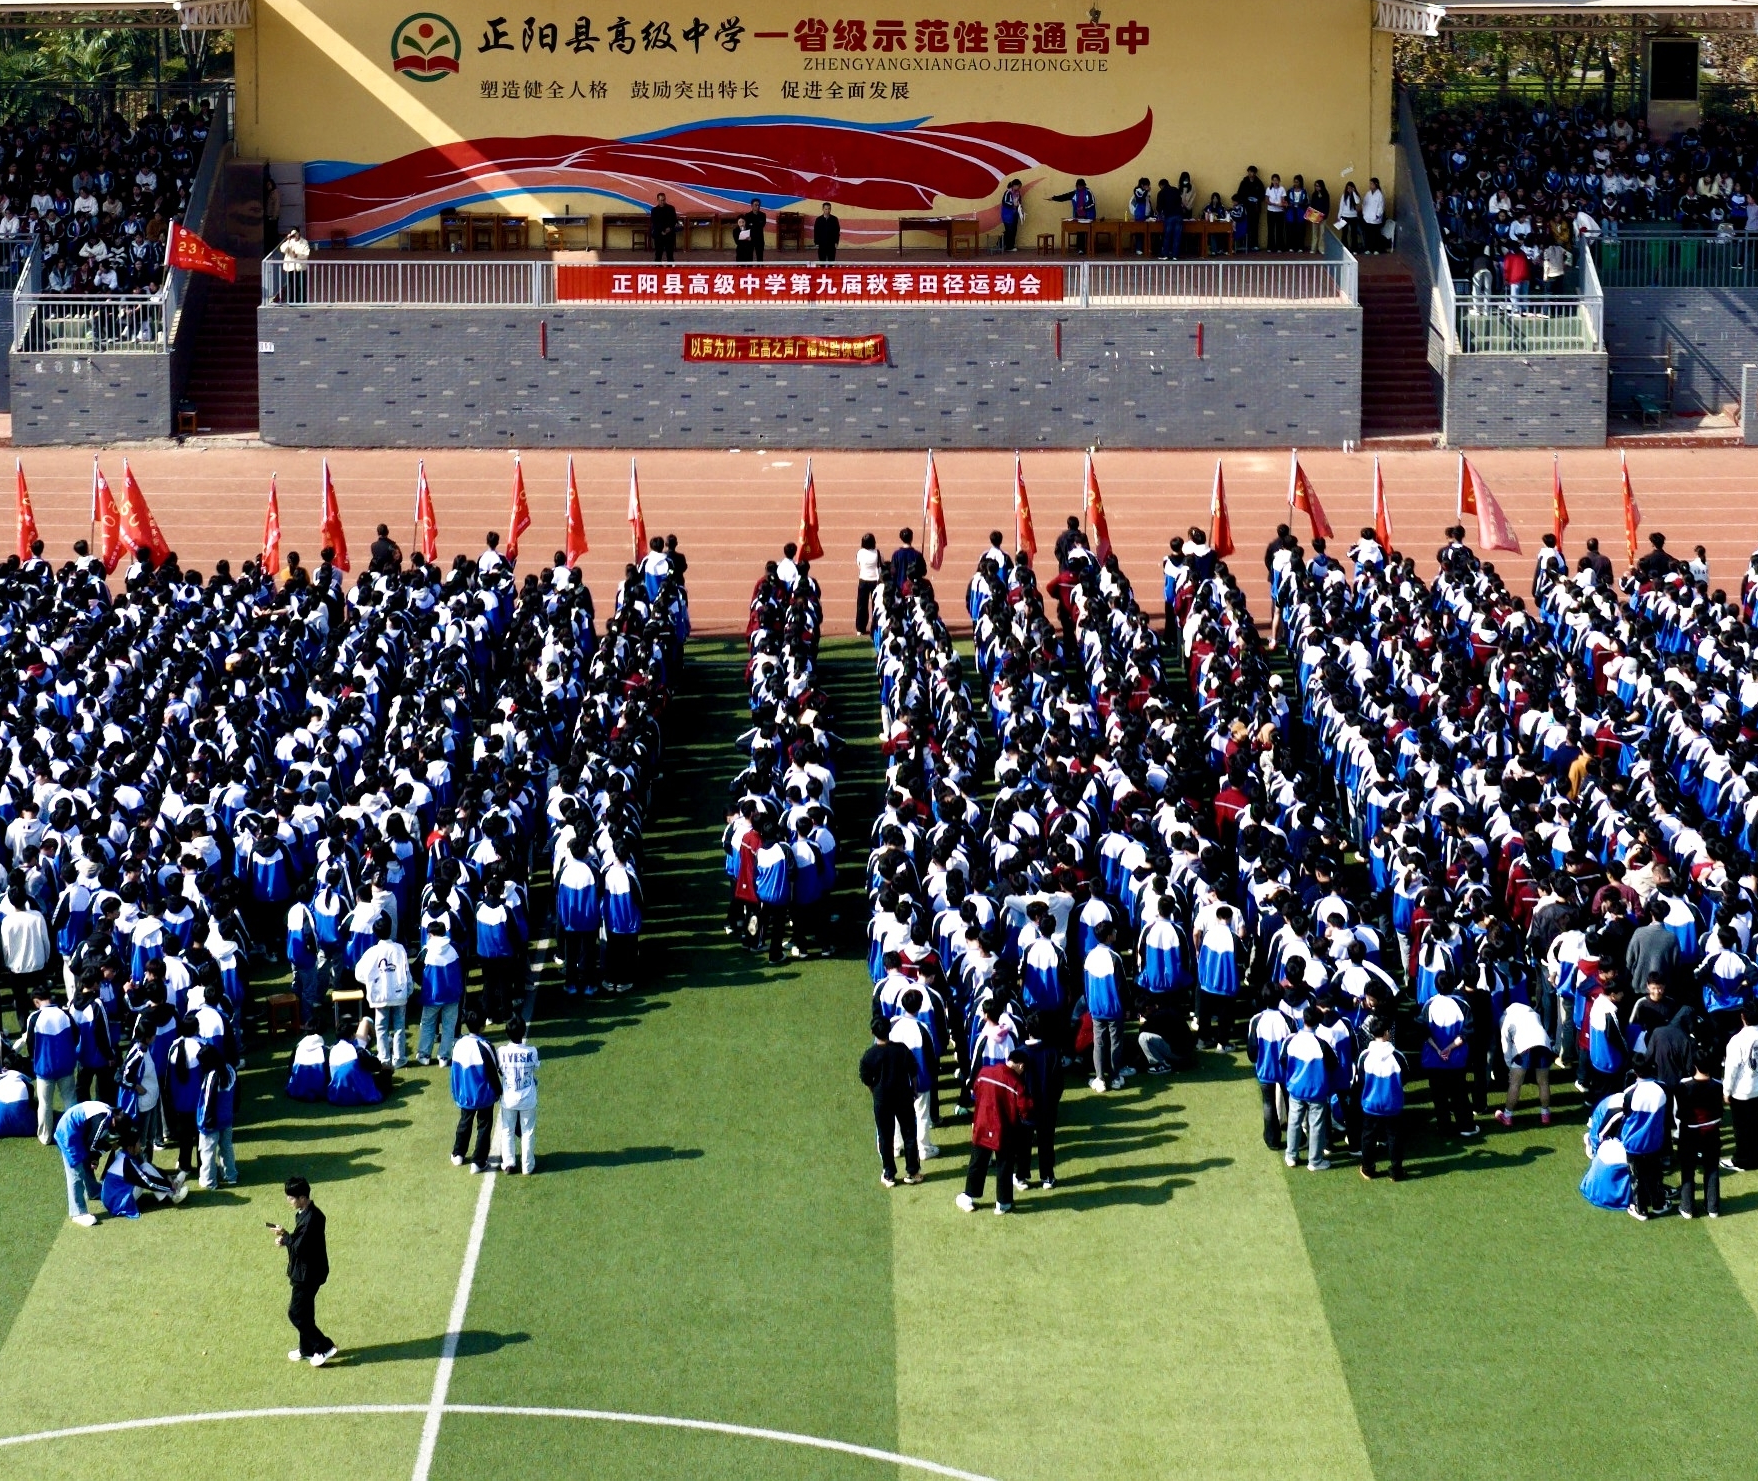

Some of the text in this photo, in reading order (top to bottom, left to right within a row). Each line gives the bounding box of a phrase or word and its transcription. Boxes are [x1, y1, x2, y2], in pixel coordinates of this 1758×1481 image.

[480, 80, 910, 100] 塑造健全人格 鼓励突出特长 促进全面发展
[611, 273, 1042, 296] 正阳县高级中学第九届秋季田径运动会
